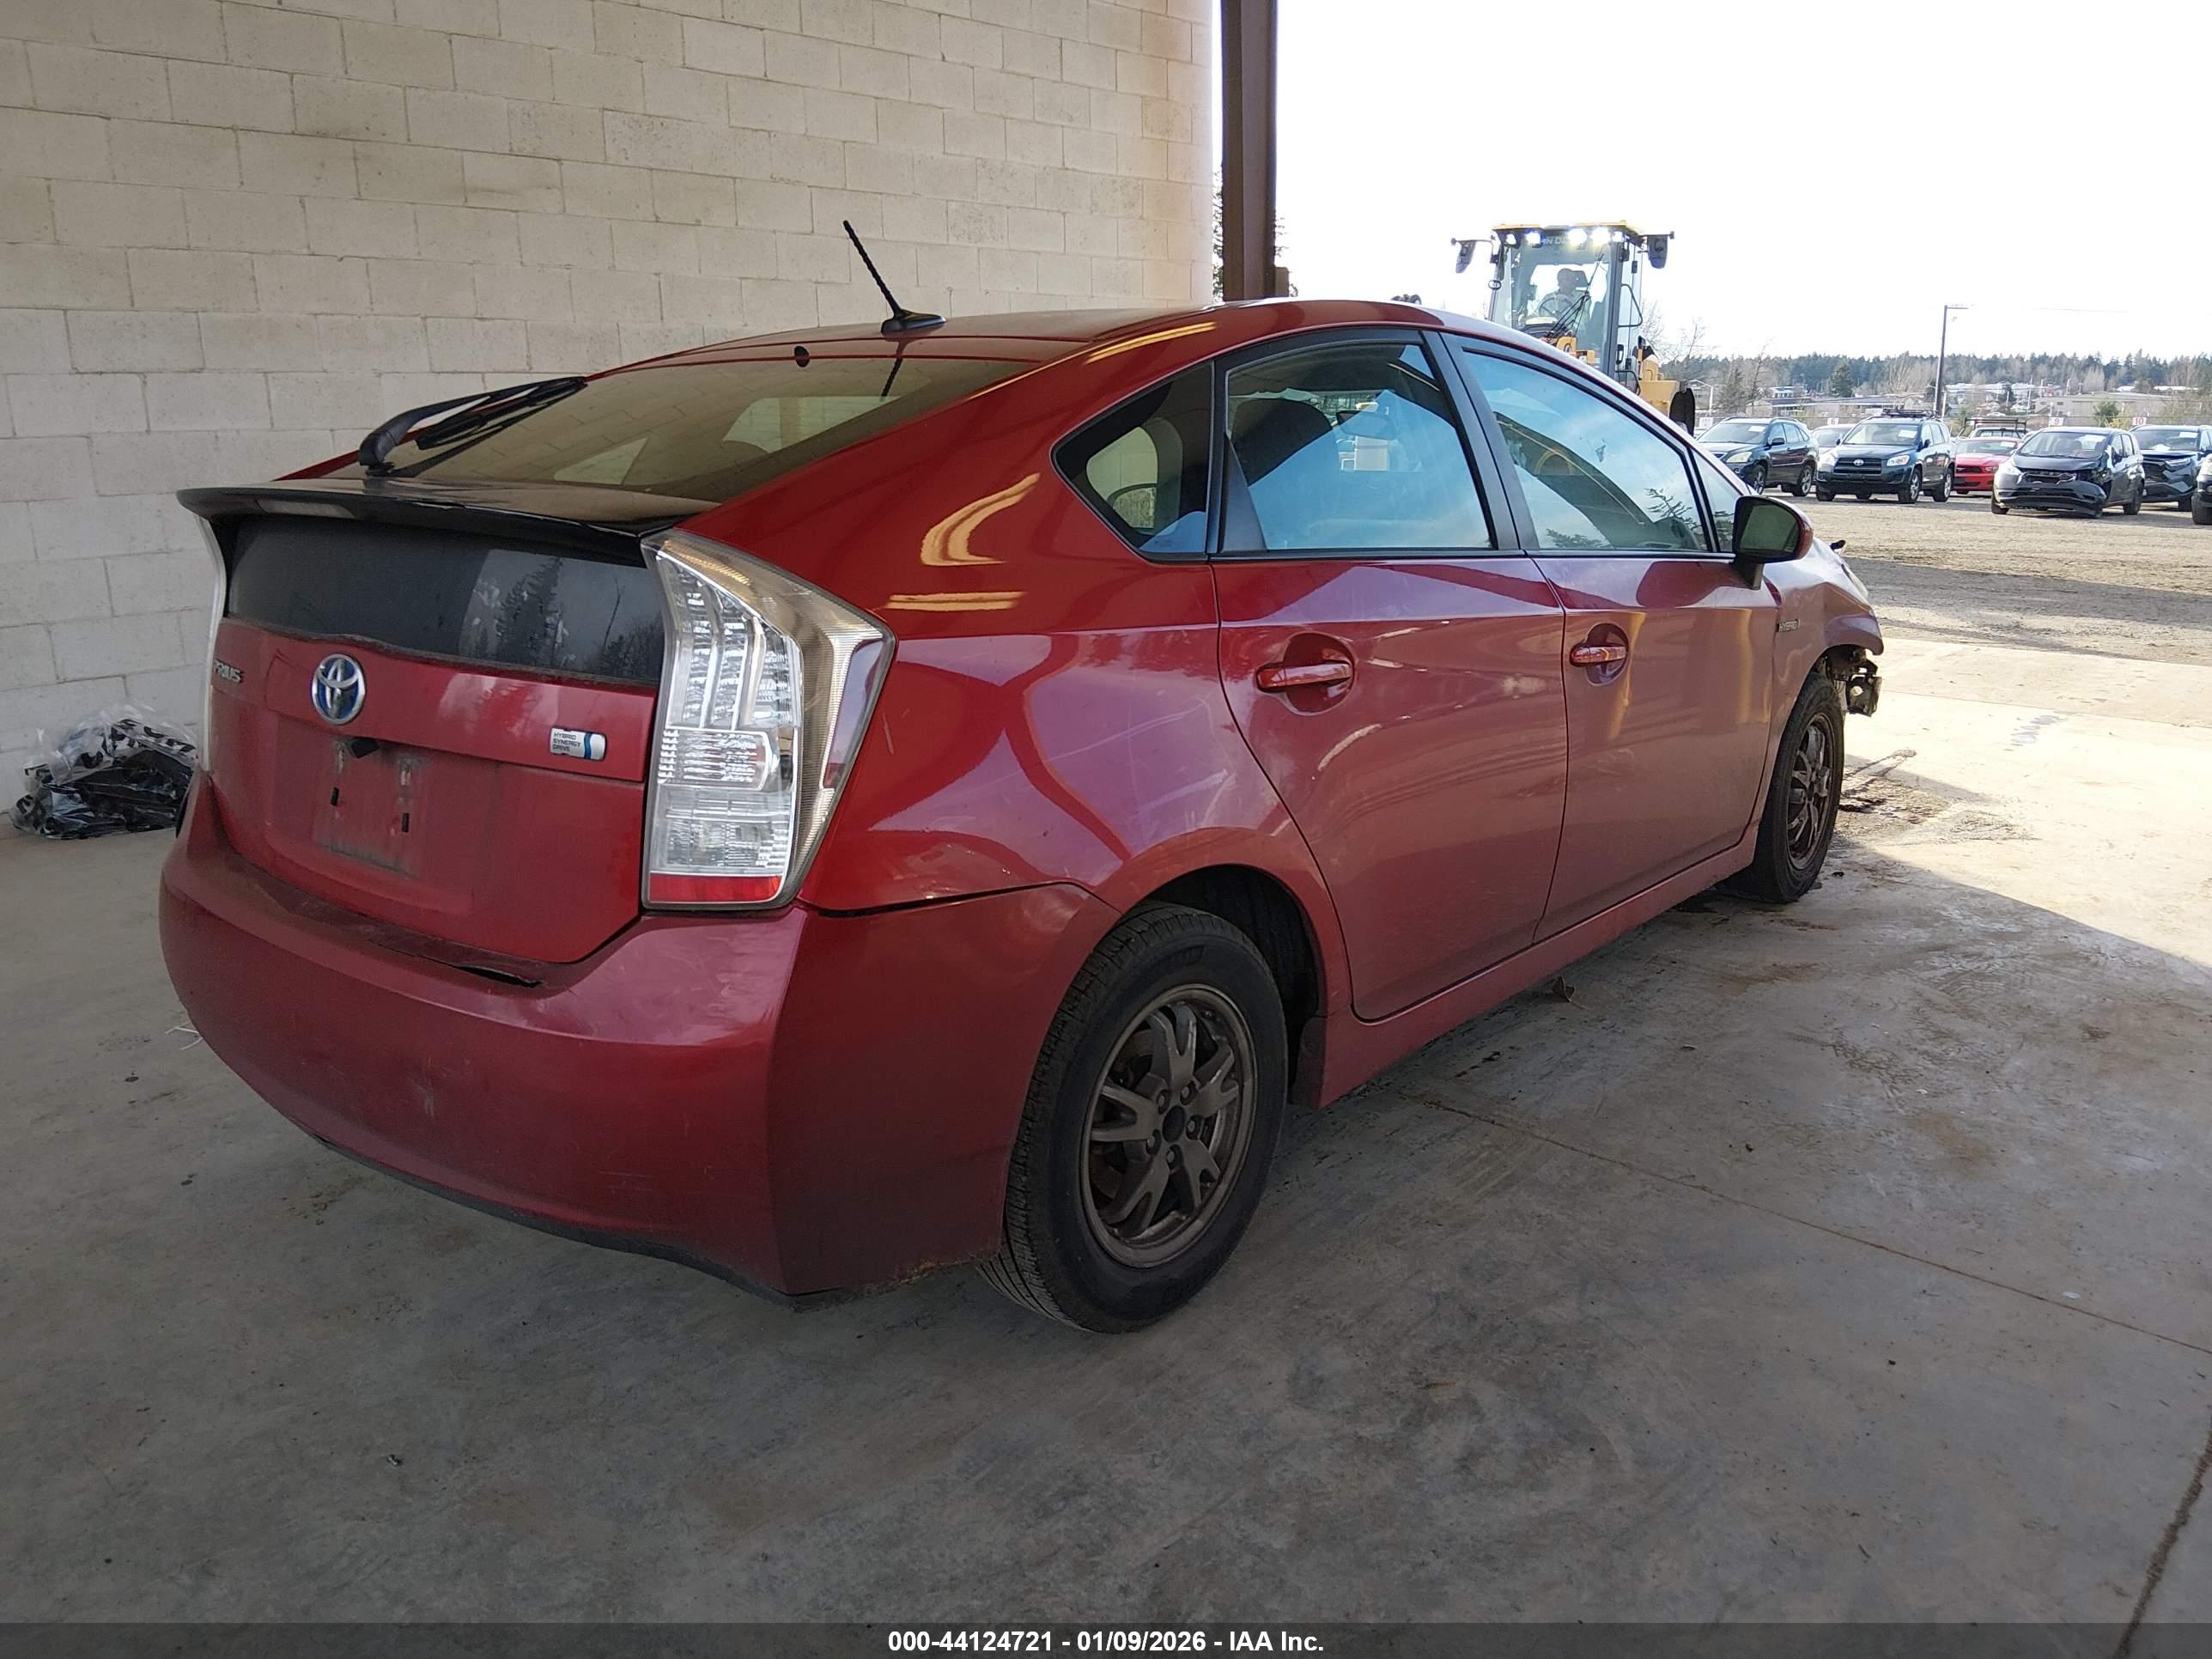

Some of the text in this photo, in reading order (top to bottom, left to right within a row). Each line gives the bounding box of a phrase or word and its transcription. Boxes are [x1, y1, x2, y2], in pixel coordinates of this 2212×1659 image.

[553, 732, 577, 740] HYBRID
[552, 738, 581, 747] SYNERGY
[552, 744, 571, 752] DRIVE
